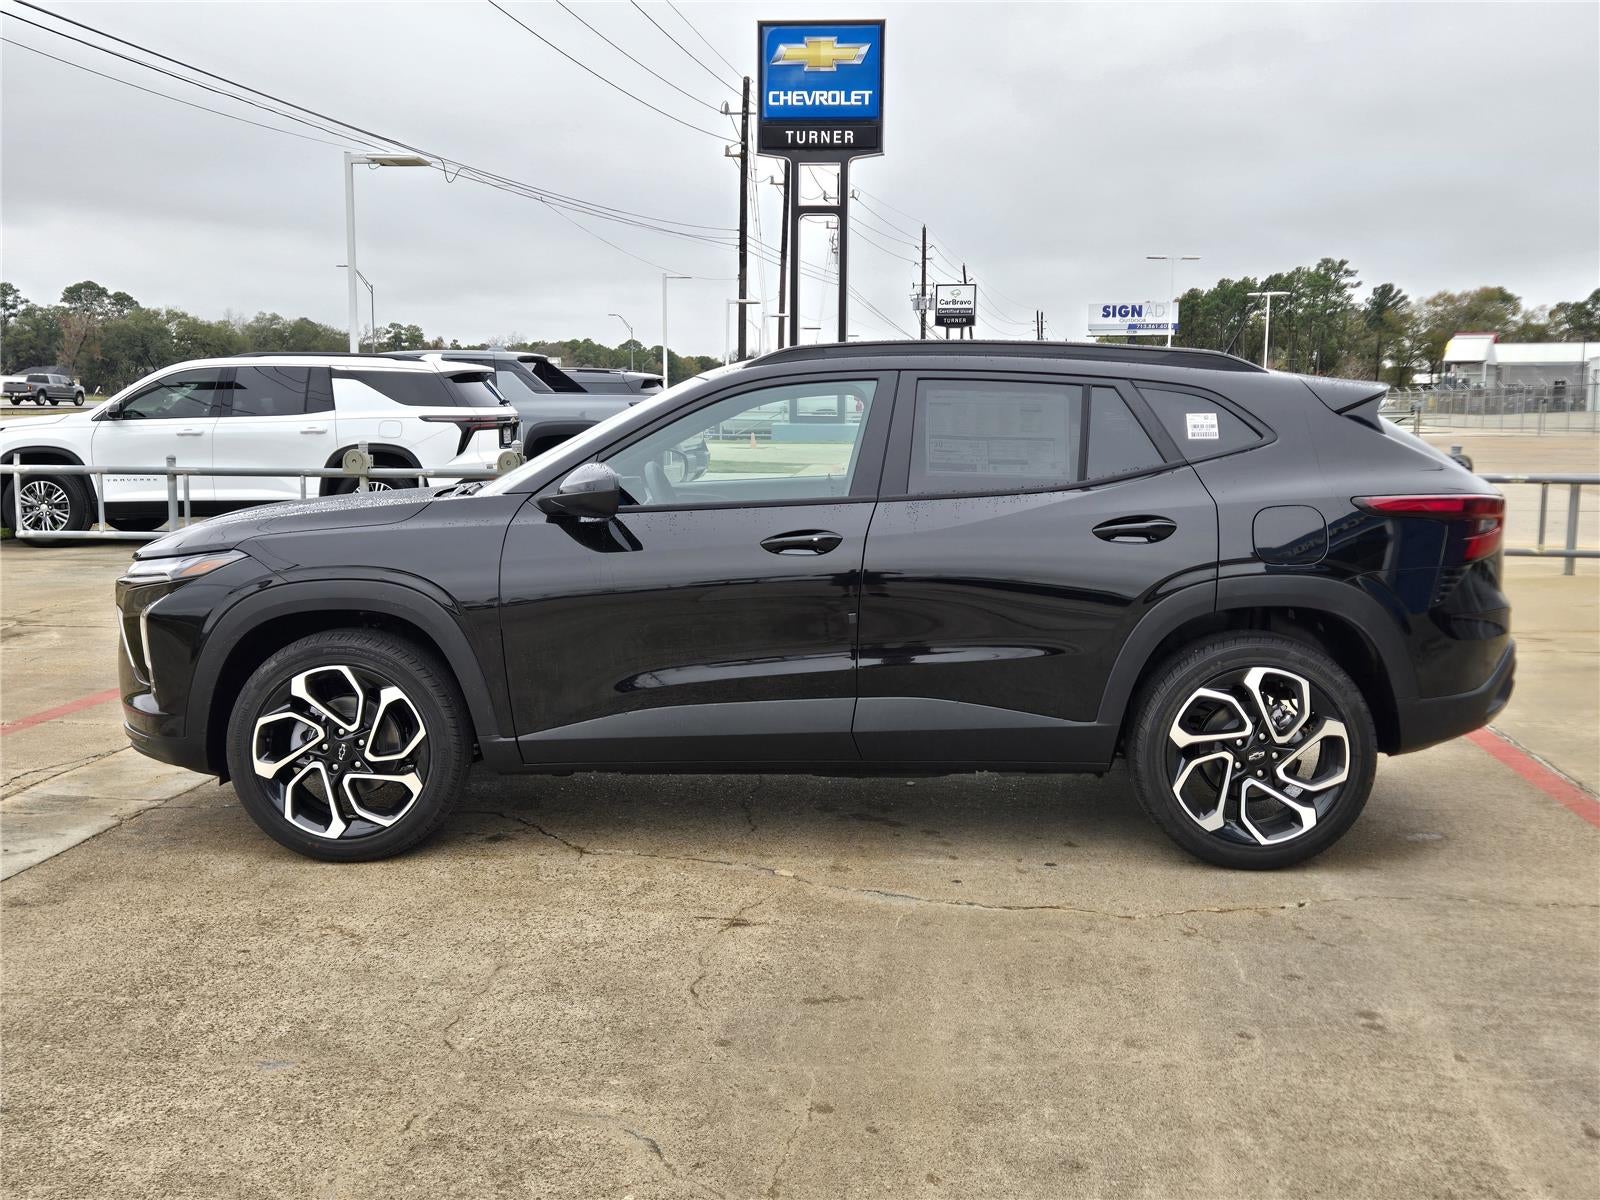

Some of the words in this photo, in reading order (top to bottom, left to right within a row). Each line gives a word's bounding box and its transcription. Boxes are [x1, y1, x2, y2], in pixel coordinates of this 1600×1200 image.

[768, 90, 873, 106] CHEVROLET
[785, 130, 854, 144] TURNER
[939, 298, 972, 306] CarBravo
